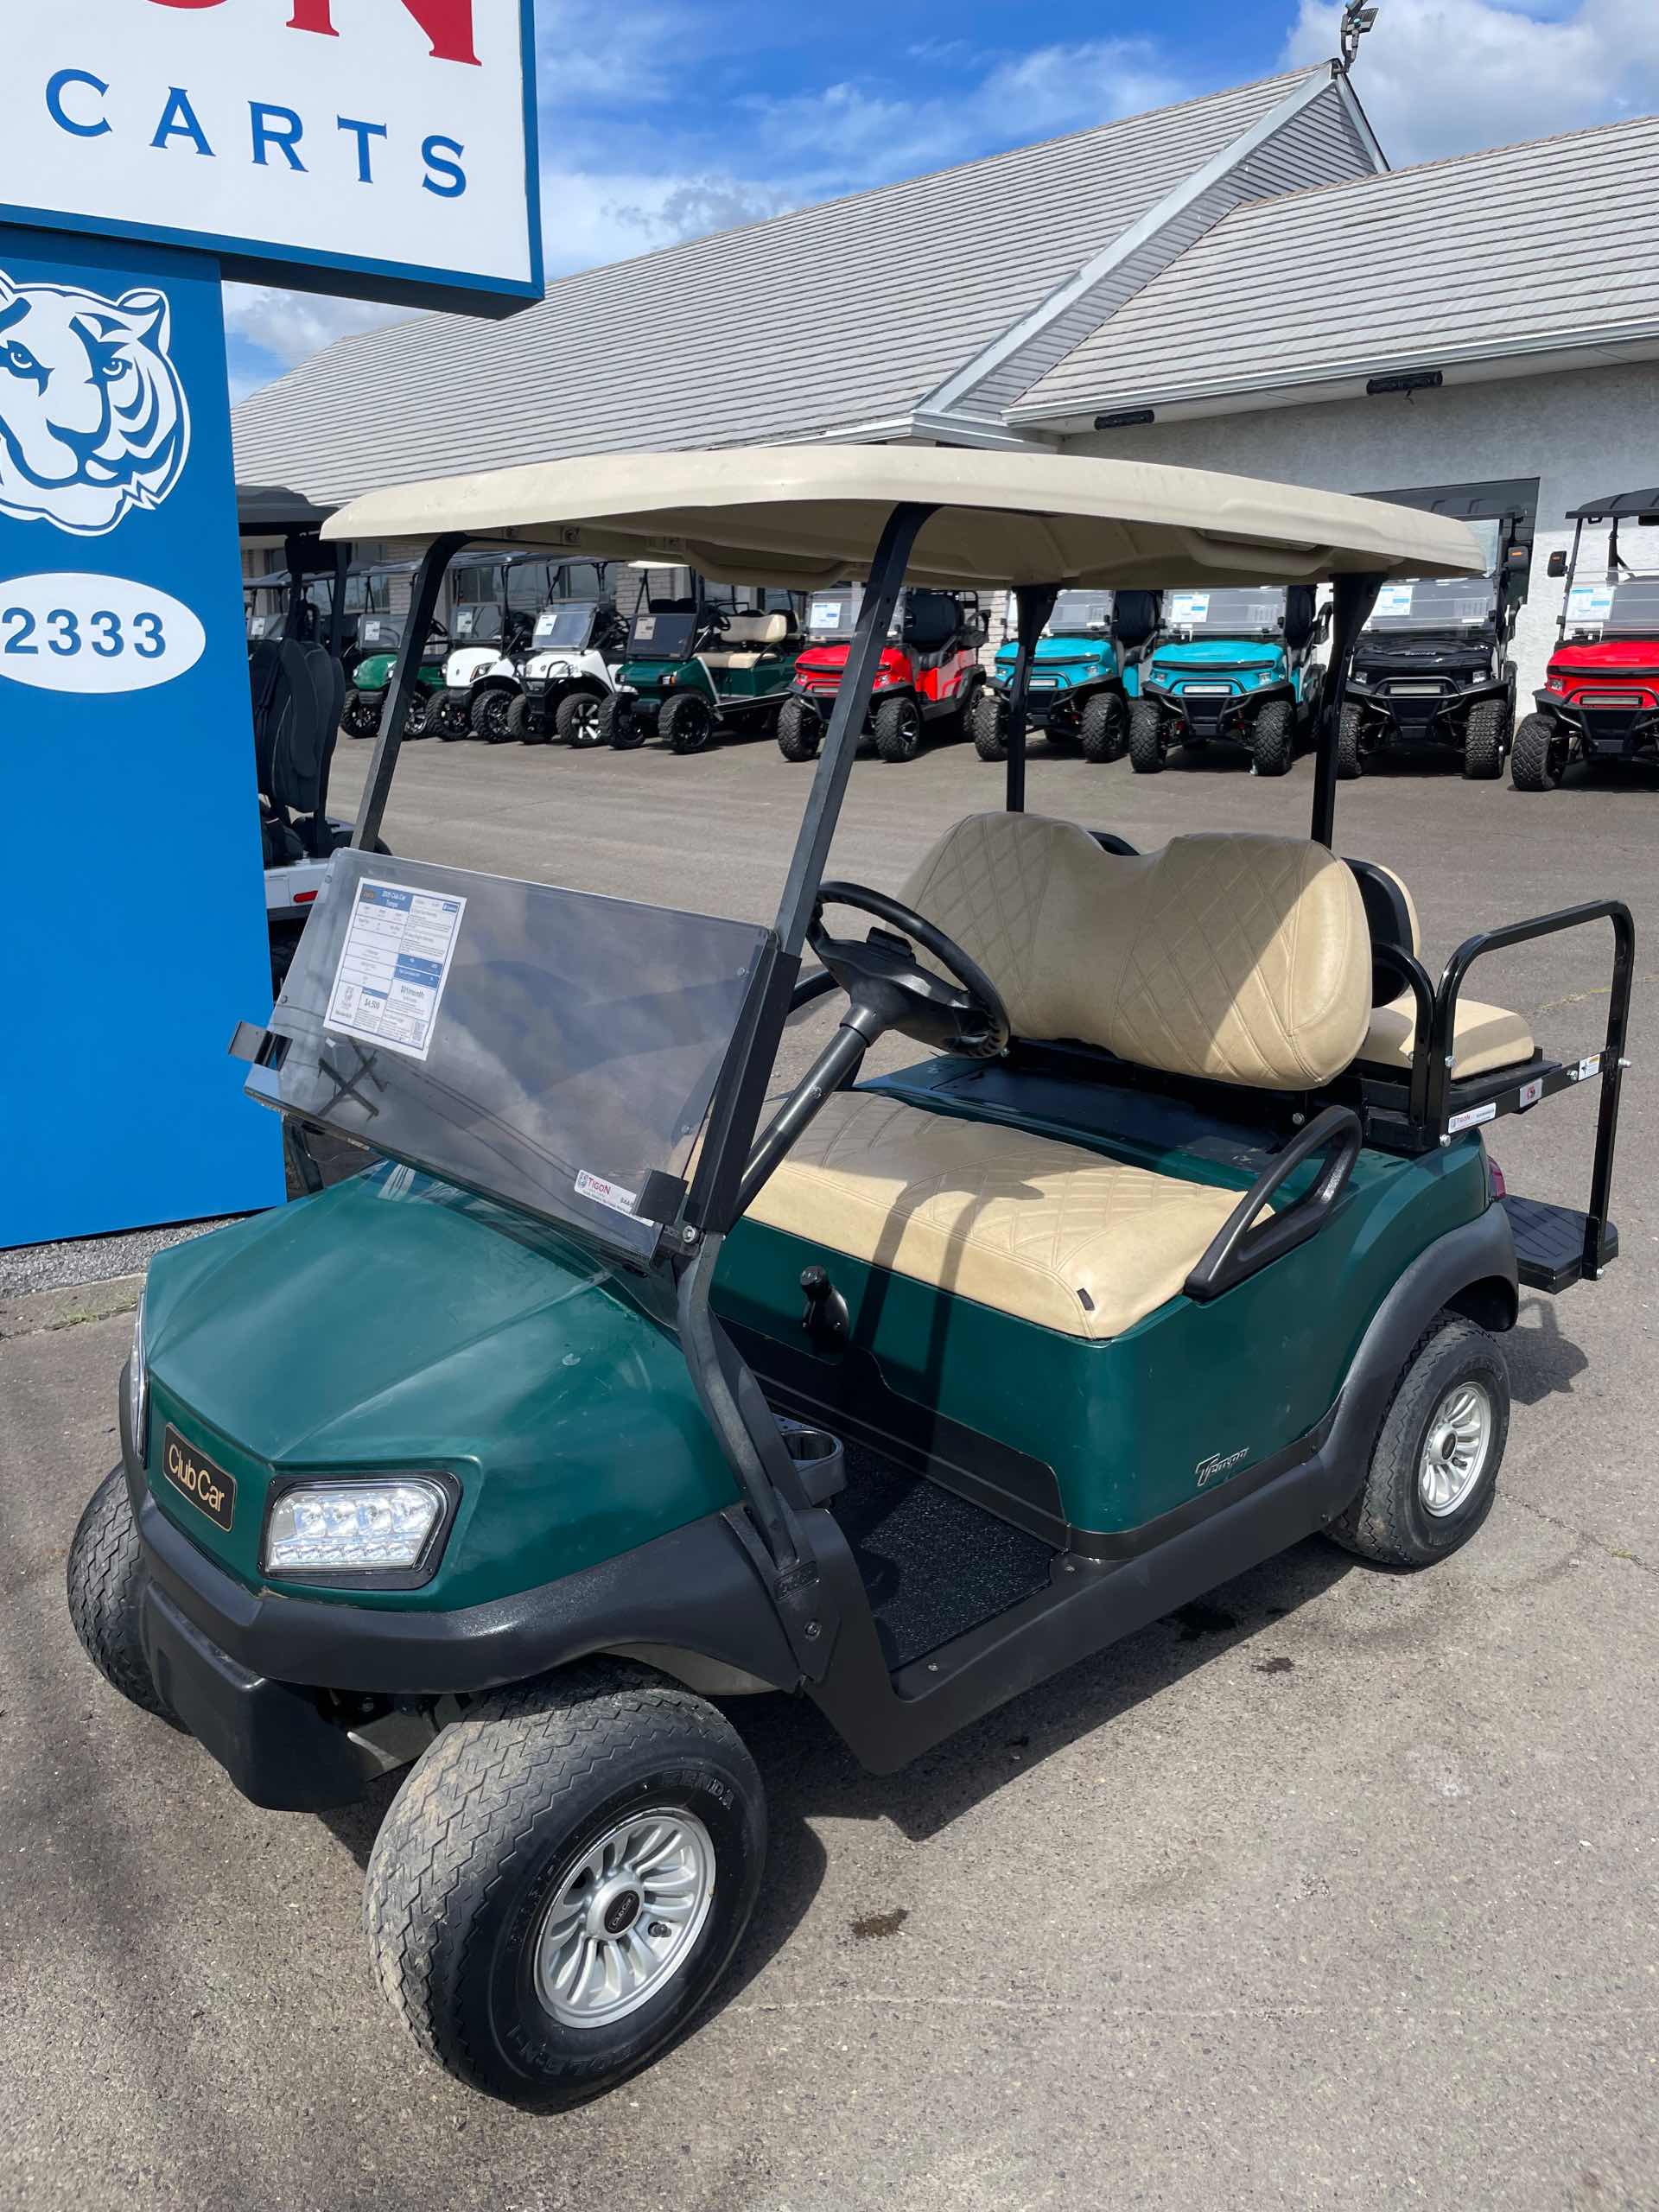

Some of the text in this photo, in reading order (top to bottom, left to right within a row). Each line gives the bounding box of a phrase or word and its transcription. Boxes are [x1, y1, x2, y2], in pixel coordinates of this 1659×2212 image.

[45, 68, 467, 198] CARTS
[2, 607, 167, 658] 2333
[588, 1178, 611, 1194] TIGON
[168, 1443, 226, 1513] Club Car
